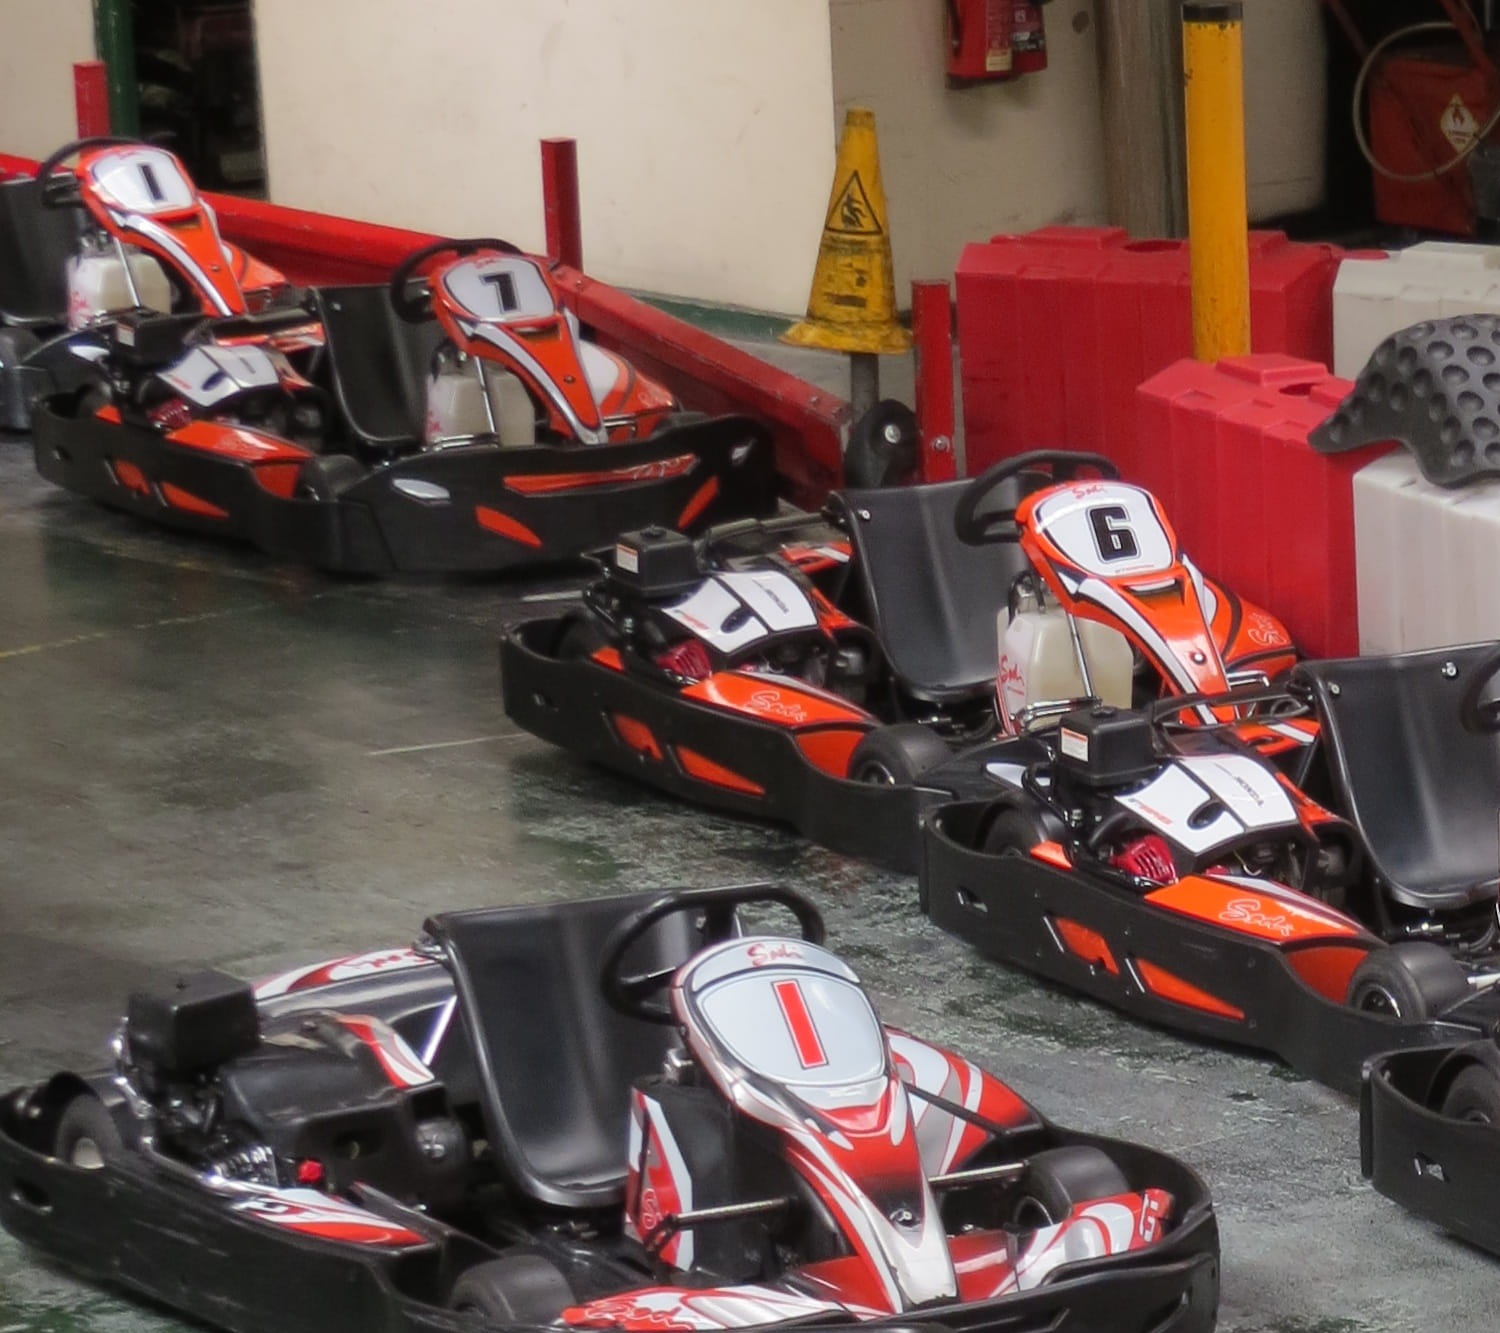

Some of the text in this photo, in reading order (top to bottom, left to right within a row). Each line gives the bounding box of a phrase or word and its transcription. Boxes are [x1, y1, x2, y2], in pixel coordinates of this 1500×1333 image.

[138, 163, 167, 201] 1
[1085, 503, 1142, 564] 6
[771, 979, 829, 1069] 1
